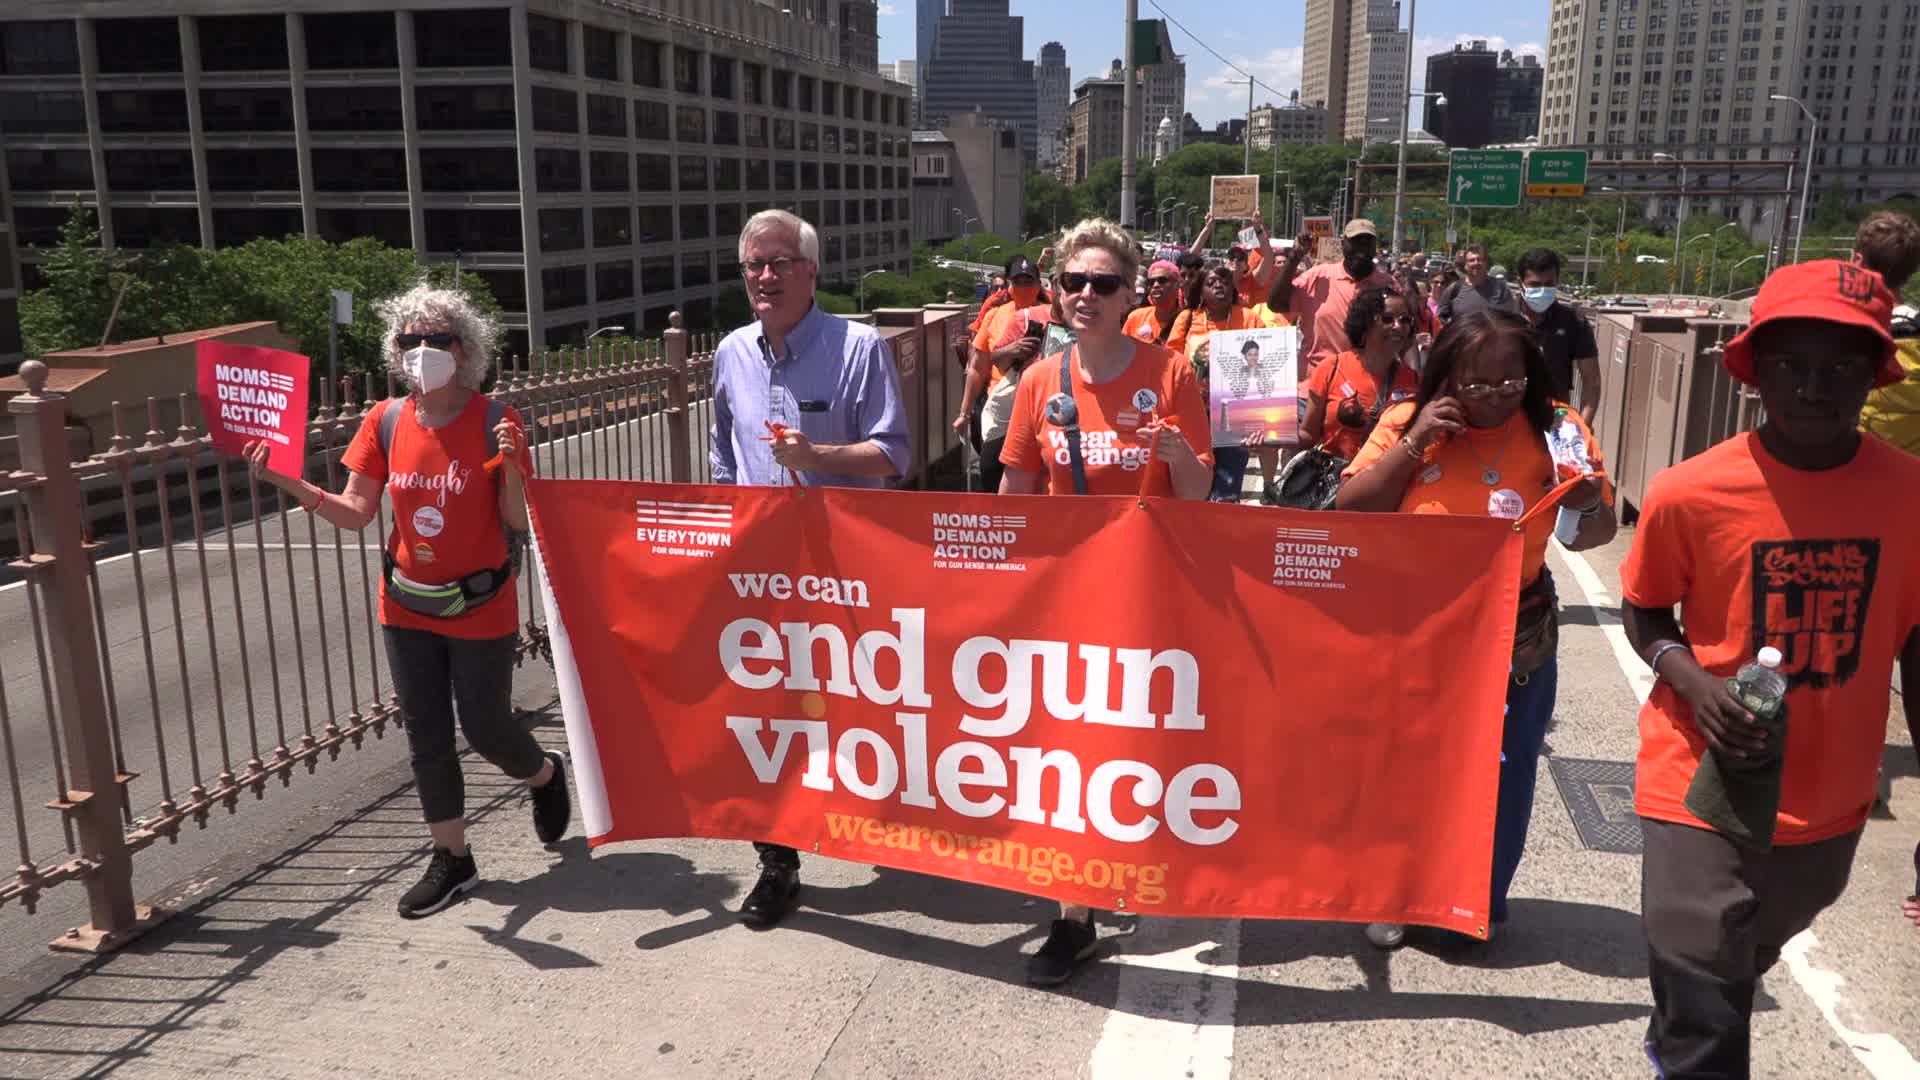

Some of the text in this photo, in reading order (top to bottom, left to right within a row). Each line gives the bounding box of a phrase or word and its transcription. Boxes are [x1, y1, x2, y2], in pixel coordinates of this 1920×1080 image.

[215, 364, 270, 387] MOMS
[217, 383, 288, 411] DEMAND
[221, 403, 281, 429] ACTION
[389, 460, 472, 508] enough
[933, 512, 992, 528] MOMS
[637, 527, 732, 547] EVERYTOWN
[934, 528, 1017, 544] DEMAND
[652, 546, 715, 557] FOR GUN SAFETY
[933, 543, 1006, 560] ACTION
[1275, 542, 1359, 558] STUDENTS
[933, 560, 1027, 571] FOR GUN SENSE IN AMERICA
[1274, 554, 1342, 569] DEMAND
[1273, 566, 1332, 580] ACTION
[728, 573, 870, 608] we can
[1766, 631, 1857, 673] UP
[718, 607, 1206, 737] end gun
[725, 693, 1242, 846] violence
[824, 812, 1169, 905] wearorange.org
